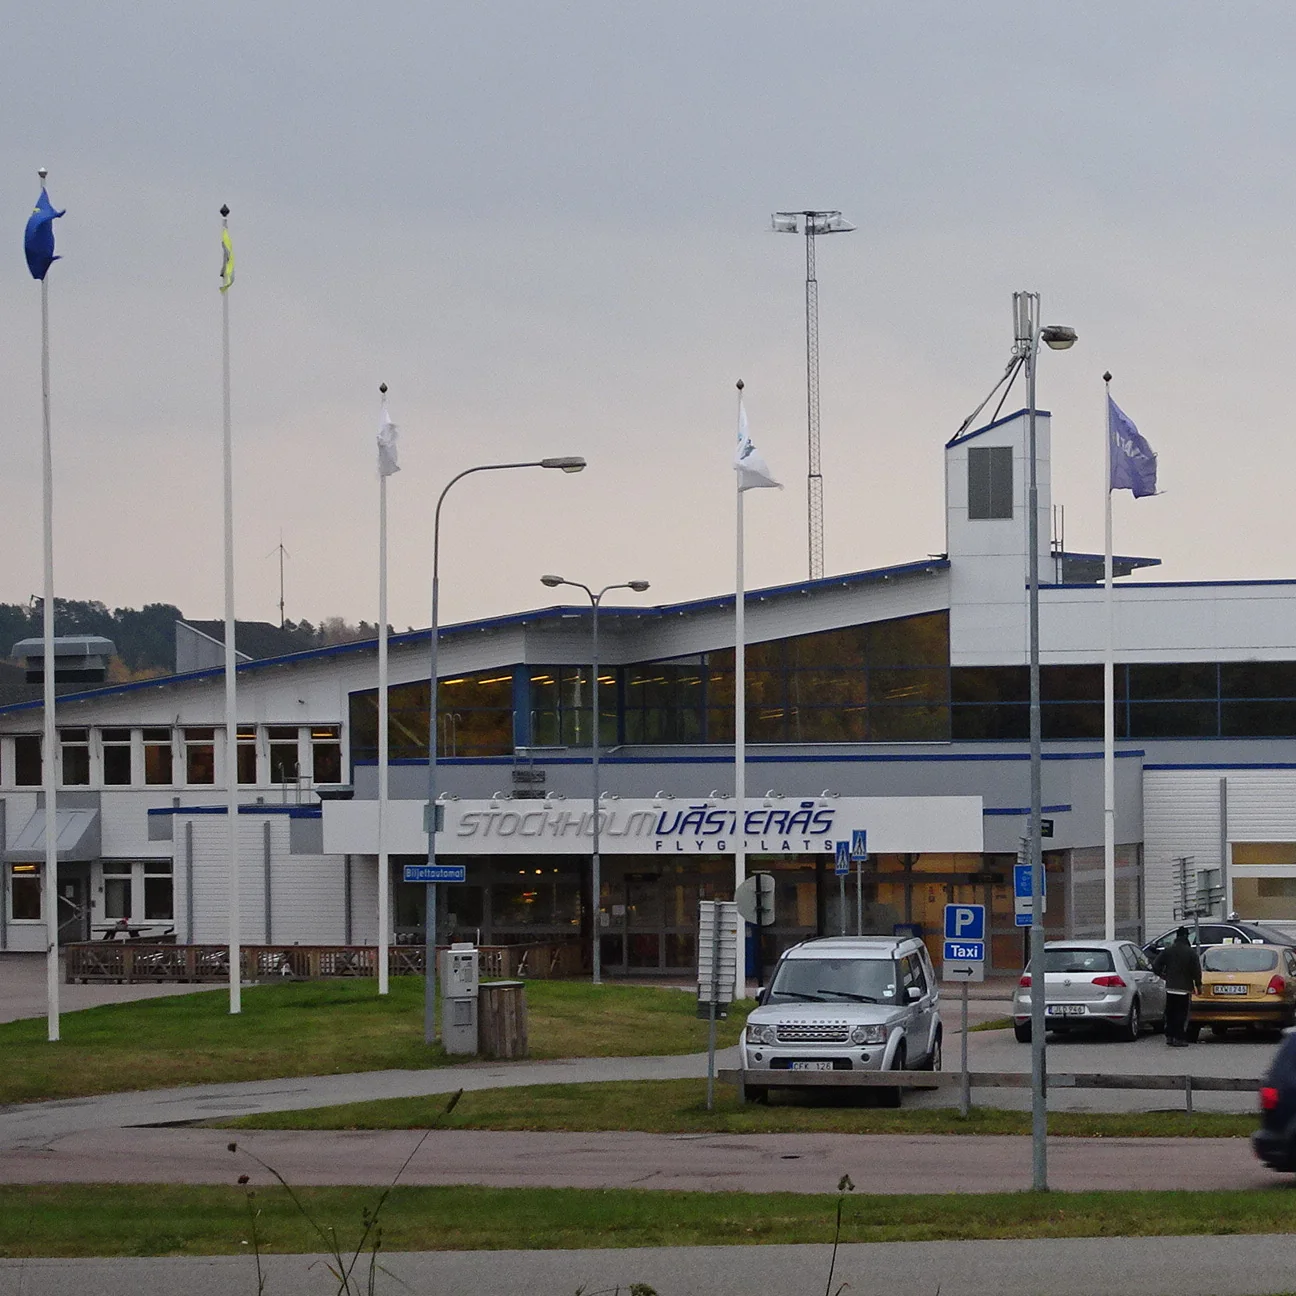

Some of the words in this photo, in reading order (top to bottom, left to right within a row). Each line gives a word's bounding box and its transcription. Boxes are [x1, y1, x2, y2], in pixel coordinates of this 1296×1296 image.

[457, 810, 659, 837] STOCKHOLM
[655, 801, 836, 835] VÄSTERÅS
[655, 840, 833, 851] FLYGLATS
[406, 868, 464, 880] Biljettautomat
[955, 908, 975, 936] P
[950, 945, 978, 958] Taxi
